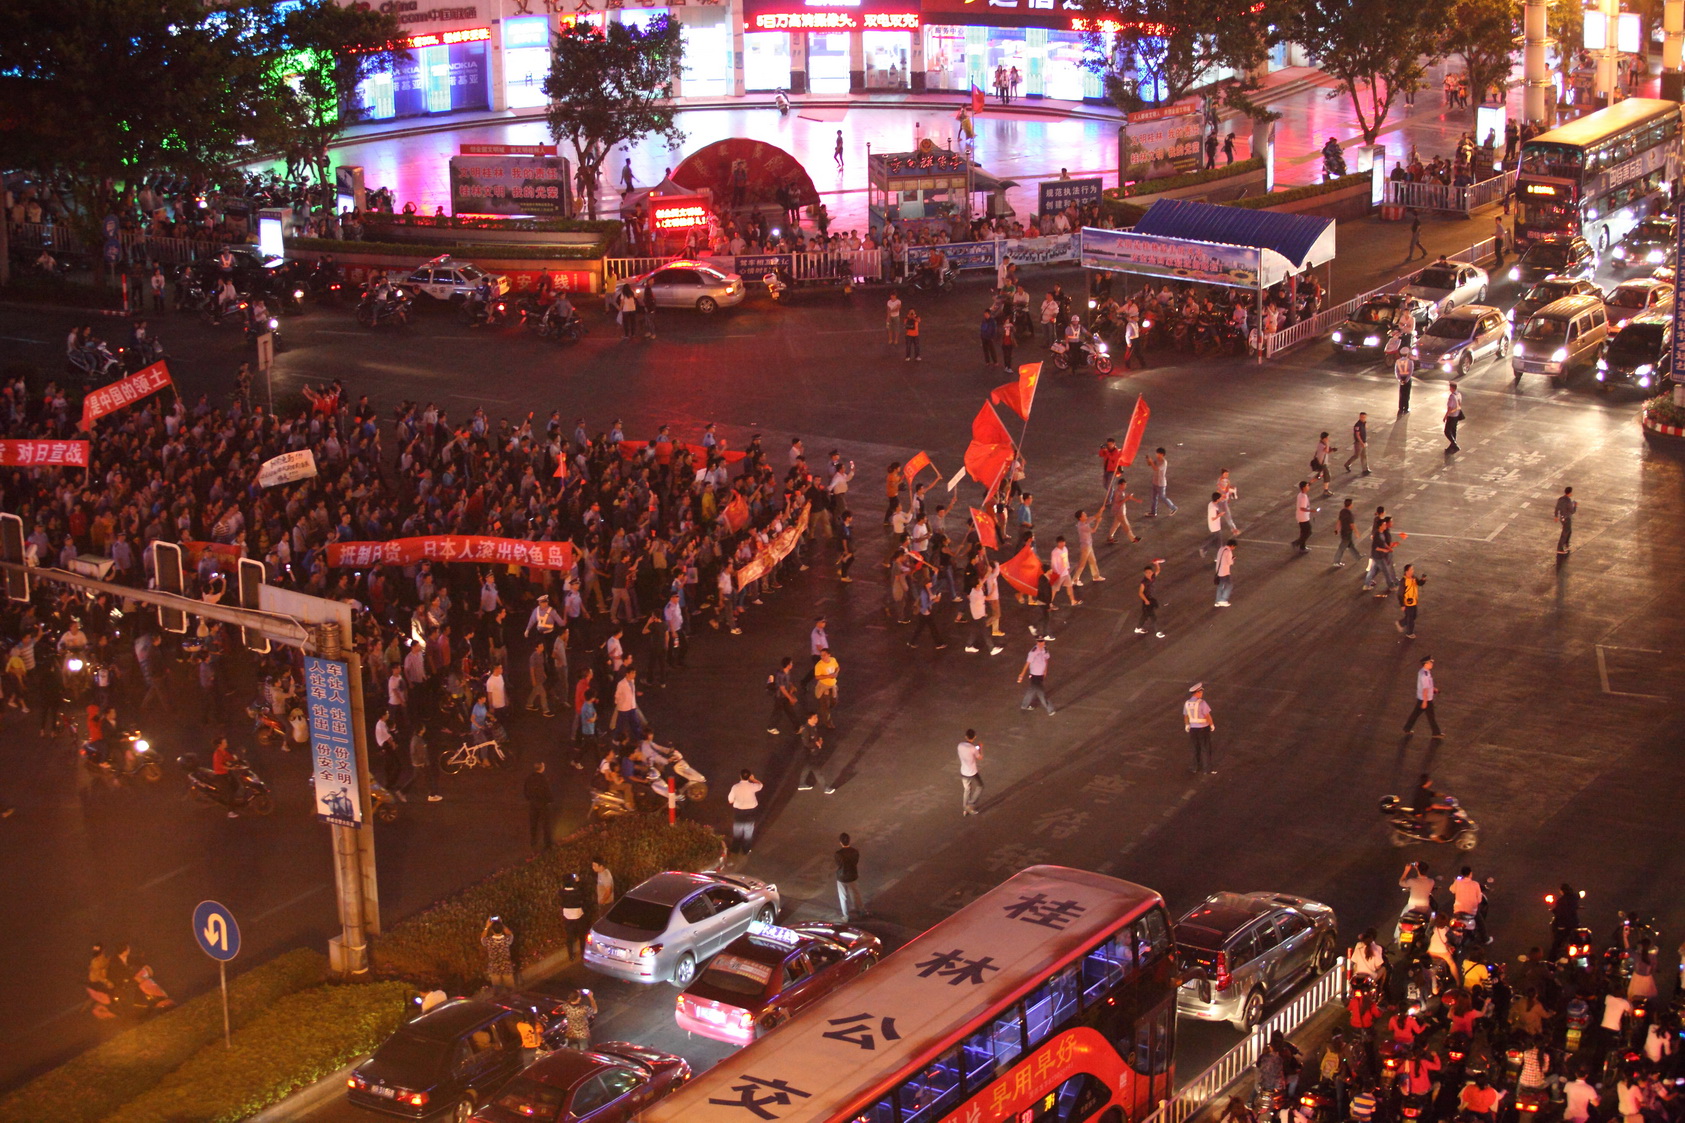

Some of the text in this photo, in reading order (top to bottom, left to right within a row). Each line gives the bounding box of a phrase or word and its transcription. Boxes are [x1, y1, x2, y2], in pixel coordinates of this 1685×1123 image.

[428, 7, 477, 21] 中国联通
[864, 13, 919, 28] 双电双充
[448, 61, 478, 71] NOKIA
[1131, 124, 1200, 146] 文明桂林 我的责任
[1130, 148, 1164, 164] 桂林文明
[1168, 141, 1200, 158] 我的光荣
[459, 167, 558, 179] 文明桂林 我的责任
[459, 185, 559, 199] 桂林文明 我的光荣
[1045, 186, 1098, 198] 规范执法行为
[89, 368, 167, 418] 是中国的领土
[17, 442, 83, 464] 对日宣战
[309, 660, 334, 782] 人让车 让出一份安全
[326, 663, 353, 785] 车让人 让出一份文明
[989, 1033, 1077, 1112] 早用早好
